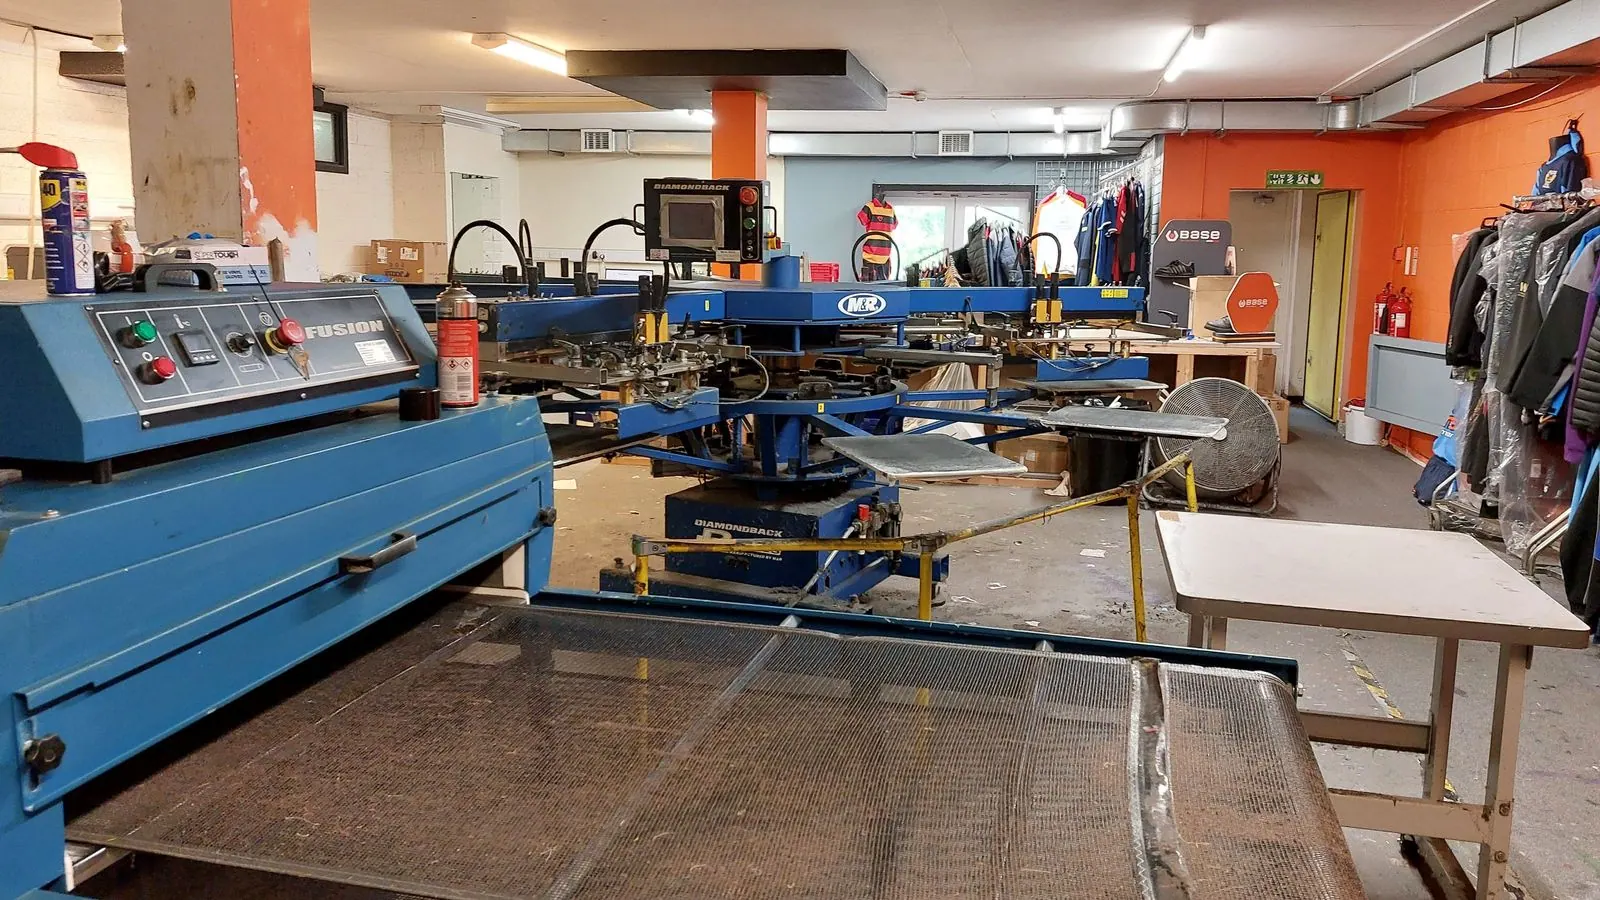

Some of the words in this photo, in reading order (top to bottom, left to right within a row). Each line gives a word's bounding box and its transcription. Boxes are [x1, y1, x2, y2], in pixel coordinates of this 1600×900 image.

[653, 183, 731, 191] DIAMONDBACK
[304, 320, 385, 340] FUSION
[694, 519, 784, 538] DIAMONDBACK
